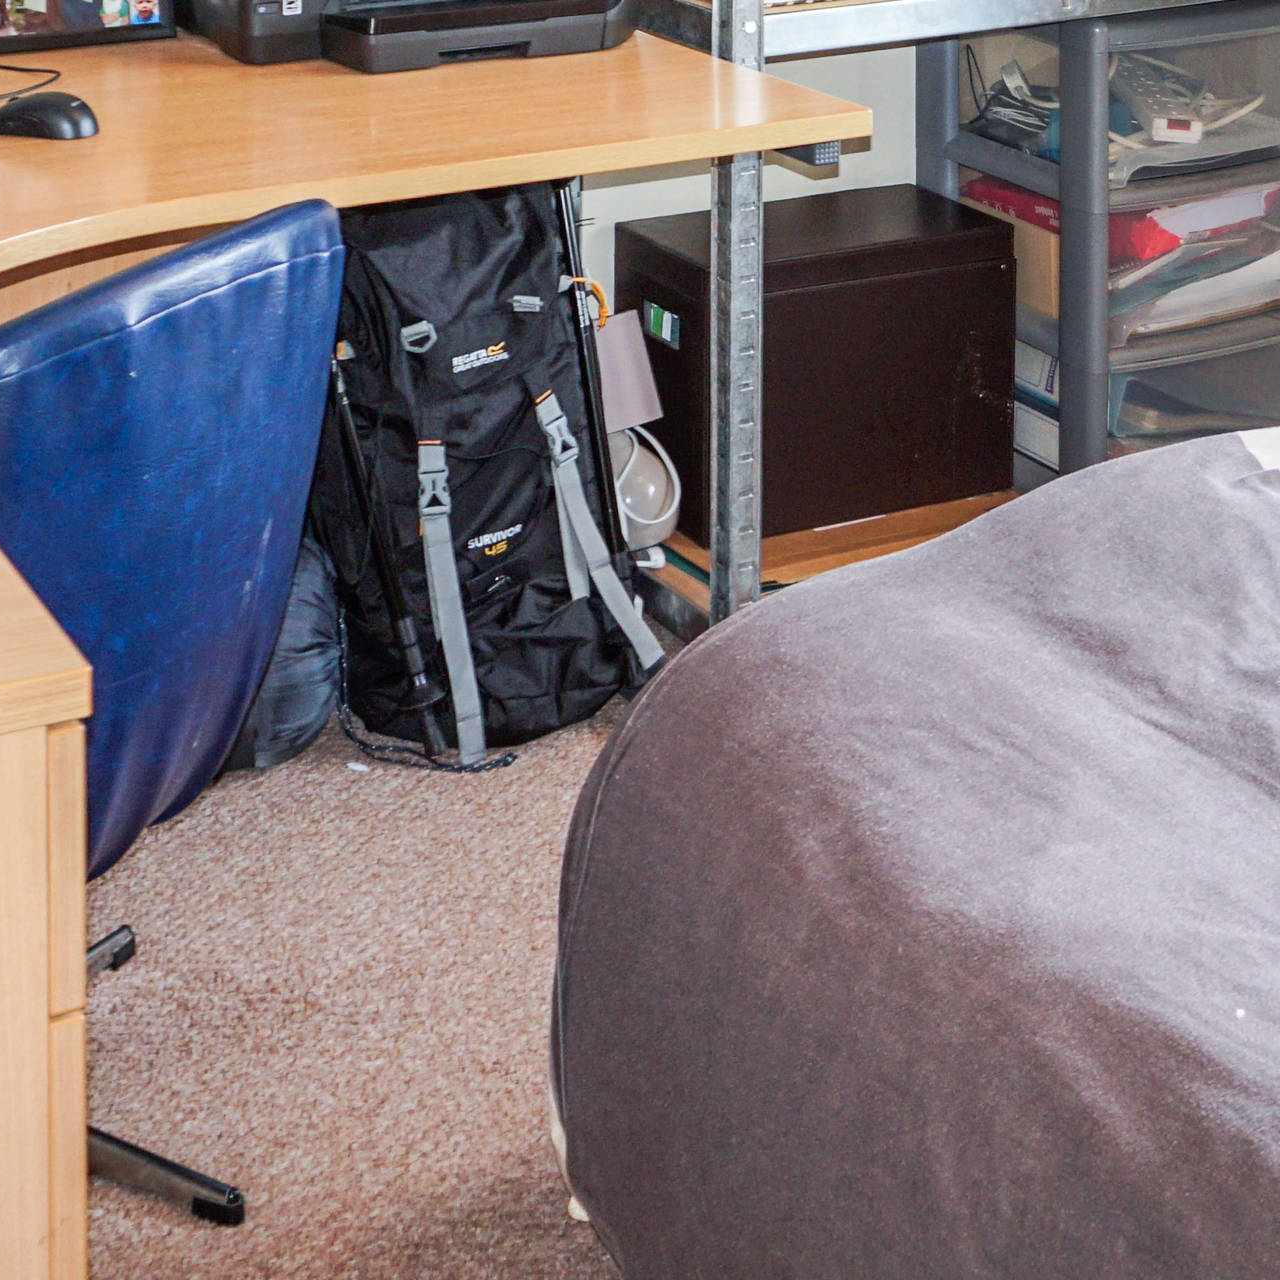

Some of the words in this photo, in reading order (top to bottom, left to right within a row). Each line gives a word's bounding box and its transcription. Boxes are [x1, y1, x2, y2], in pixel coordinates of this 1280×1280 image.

[452, 348, 488, 367] REGATTA
[467, 523, 523, 549] SURVIVOR
[484, 539, 508, 556] 45
